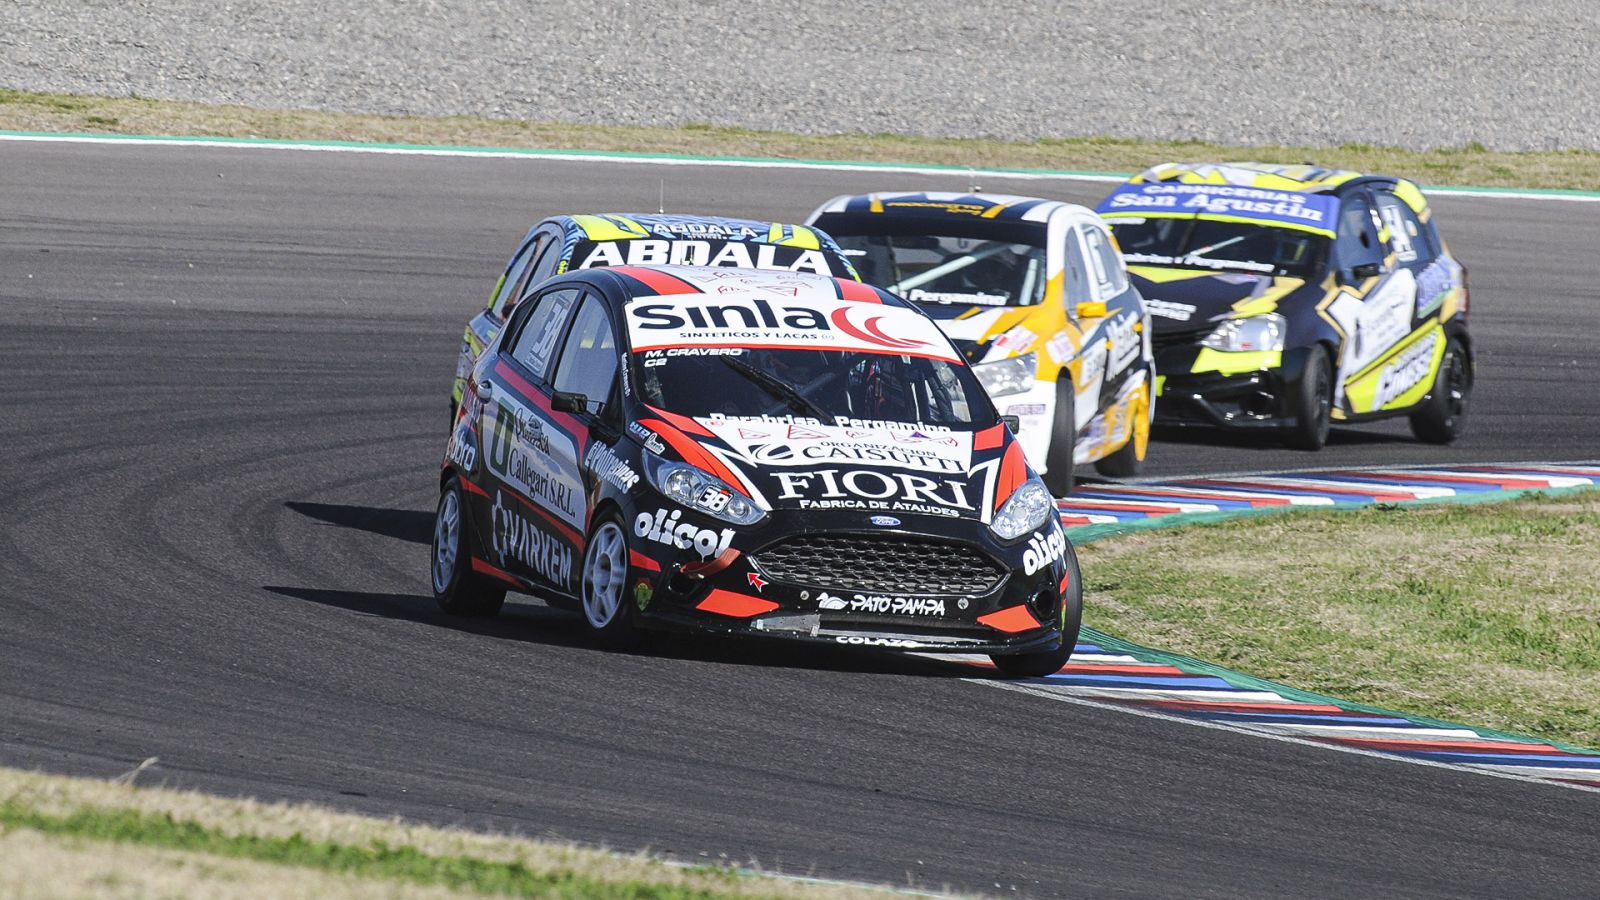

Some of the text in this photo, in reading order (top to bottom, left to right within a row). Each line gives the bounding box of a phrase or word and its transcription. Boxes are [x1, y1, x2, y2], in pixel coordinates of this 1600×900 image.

[1142, 185, 1307, 204] CARNICERIAS
[1110, 193, 1324, 222] San Agustin
[653, 223, 758, 239] ABDALA
[578, 239, 834, 277] ABDALA
[775, 333, 818, 341] LACAS
[645, 348, 743, 358] M. CRAVERO
[803, 445, 966, 472] CAISUTTI
[820, 441, 937, 457] ORGANIZACION
[509, 447, 550, 499] Callegari
[702, 488, 730, 512] 38
[769, 470, 977, 511] FIORI
[799, 500, 960, 517] FABRICA DE ATAUDES
[850, 594, 946, 616] PATO PAMPA
[835, 635, 921, 648] COLAZO
